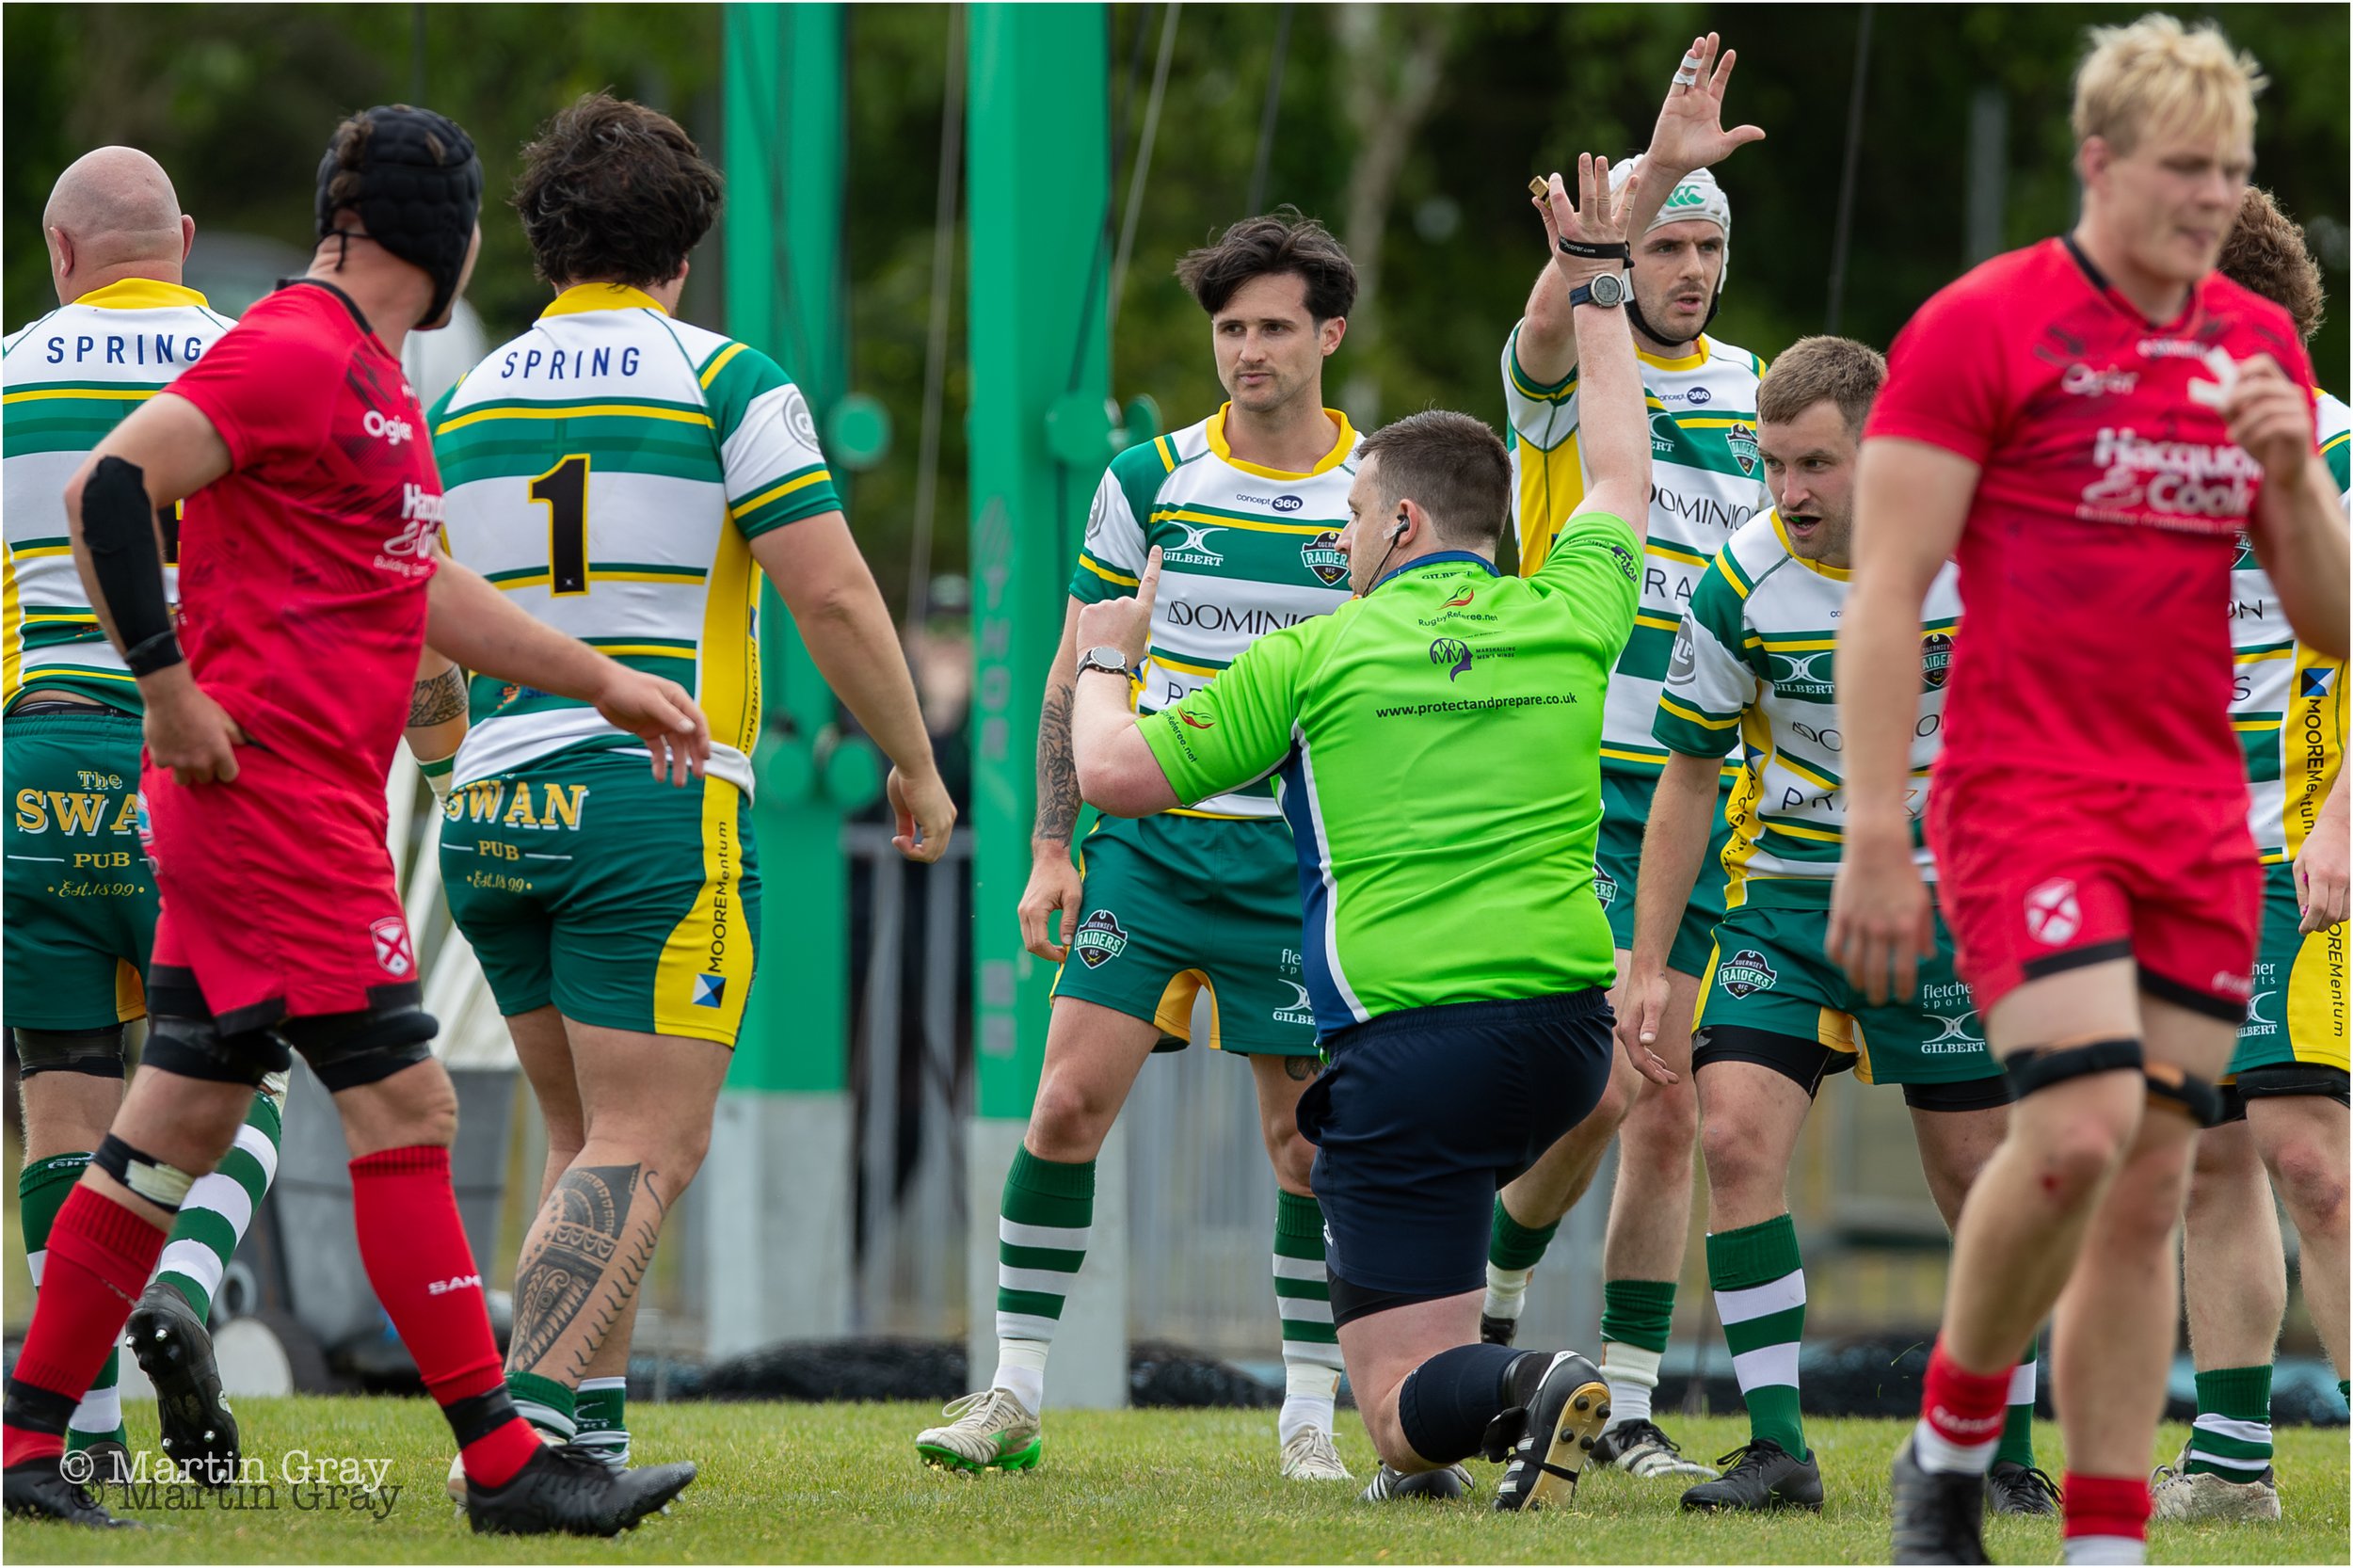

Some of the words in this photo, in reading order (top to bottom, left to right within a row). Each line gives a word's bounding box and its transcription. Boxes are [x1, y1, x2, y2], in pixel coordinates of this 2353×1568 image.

[46, 333, 202, 365] SPRING
[501, 346, 640, 379] SPRING
[1689, 391, 1710, 400] 360
[1730, 441, 1759, 459] RAIDERS
[1236, 493, 1271, 505] concept
[1274, 498, 1300, 509] 360
[528, 453, 591, 599] 1
[1162, 551, 1224, 567] GILBERT
[1306, 552, 1348, 567] RAIDER
[1167, 600, 1318, 635] DOMINI
[1418, 610, 1499, 627] RugbyReferee.net
[1922, 653, 1954, 670] AIDER
[1773, 682, 1835, 696] GILBERT
[1376, 692, 1578, 719] www.protectandprepare.co.uk
[78, 770, 122, 791] The
[16, 788, 140, 837] SWA
[478, 840, 520, 861] PUB
[73, 851, 131, 869] PUB
[708, 821, 728, 973] MOOREMentum
[1088, 920, 1113, 932] GUERNSEY
[1077, 930, 1122, 952] RAIDERS
[1735, 958, 1765, 970] GUERNSEY
[1721, 969, 1772, 988] RAIDERS
[2328, 922, 2345, 1037] OREMentum
[1923, 981, 1974, 1000] fletche
[1923, 996, 1971, 1009] sport
[1273, 1011, 1316, 1026] GILBE
[1921, 1041, 1986, 1054] GILBERT
